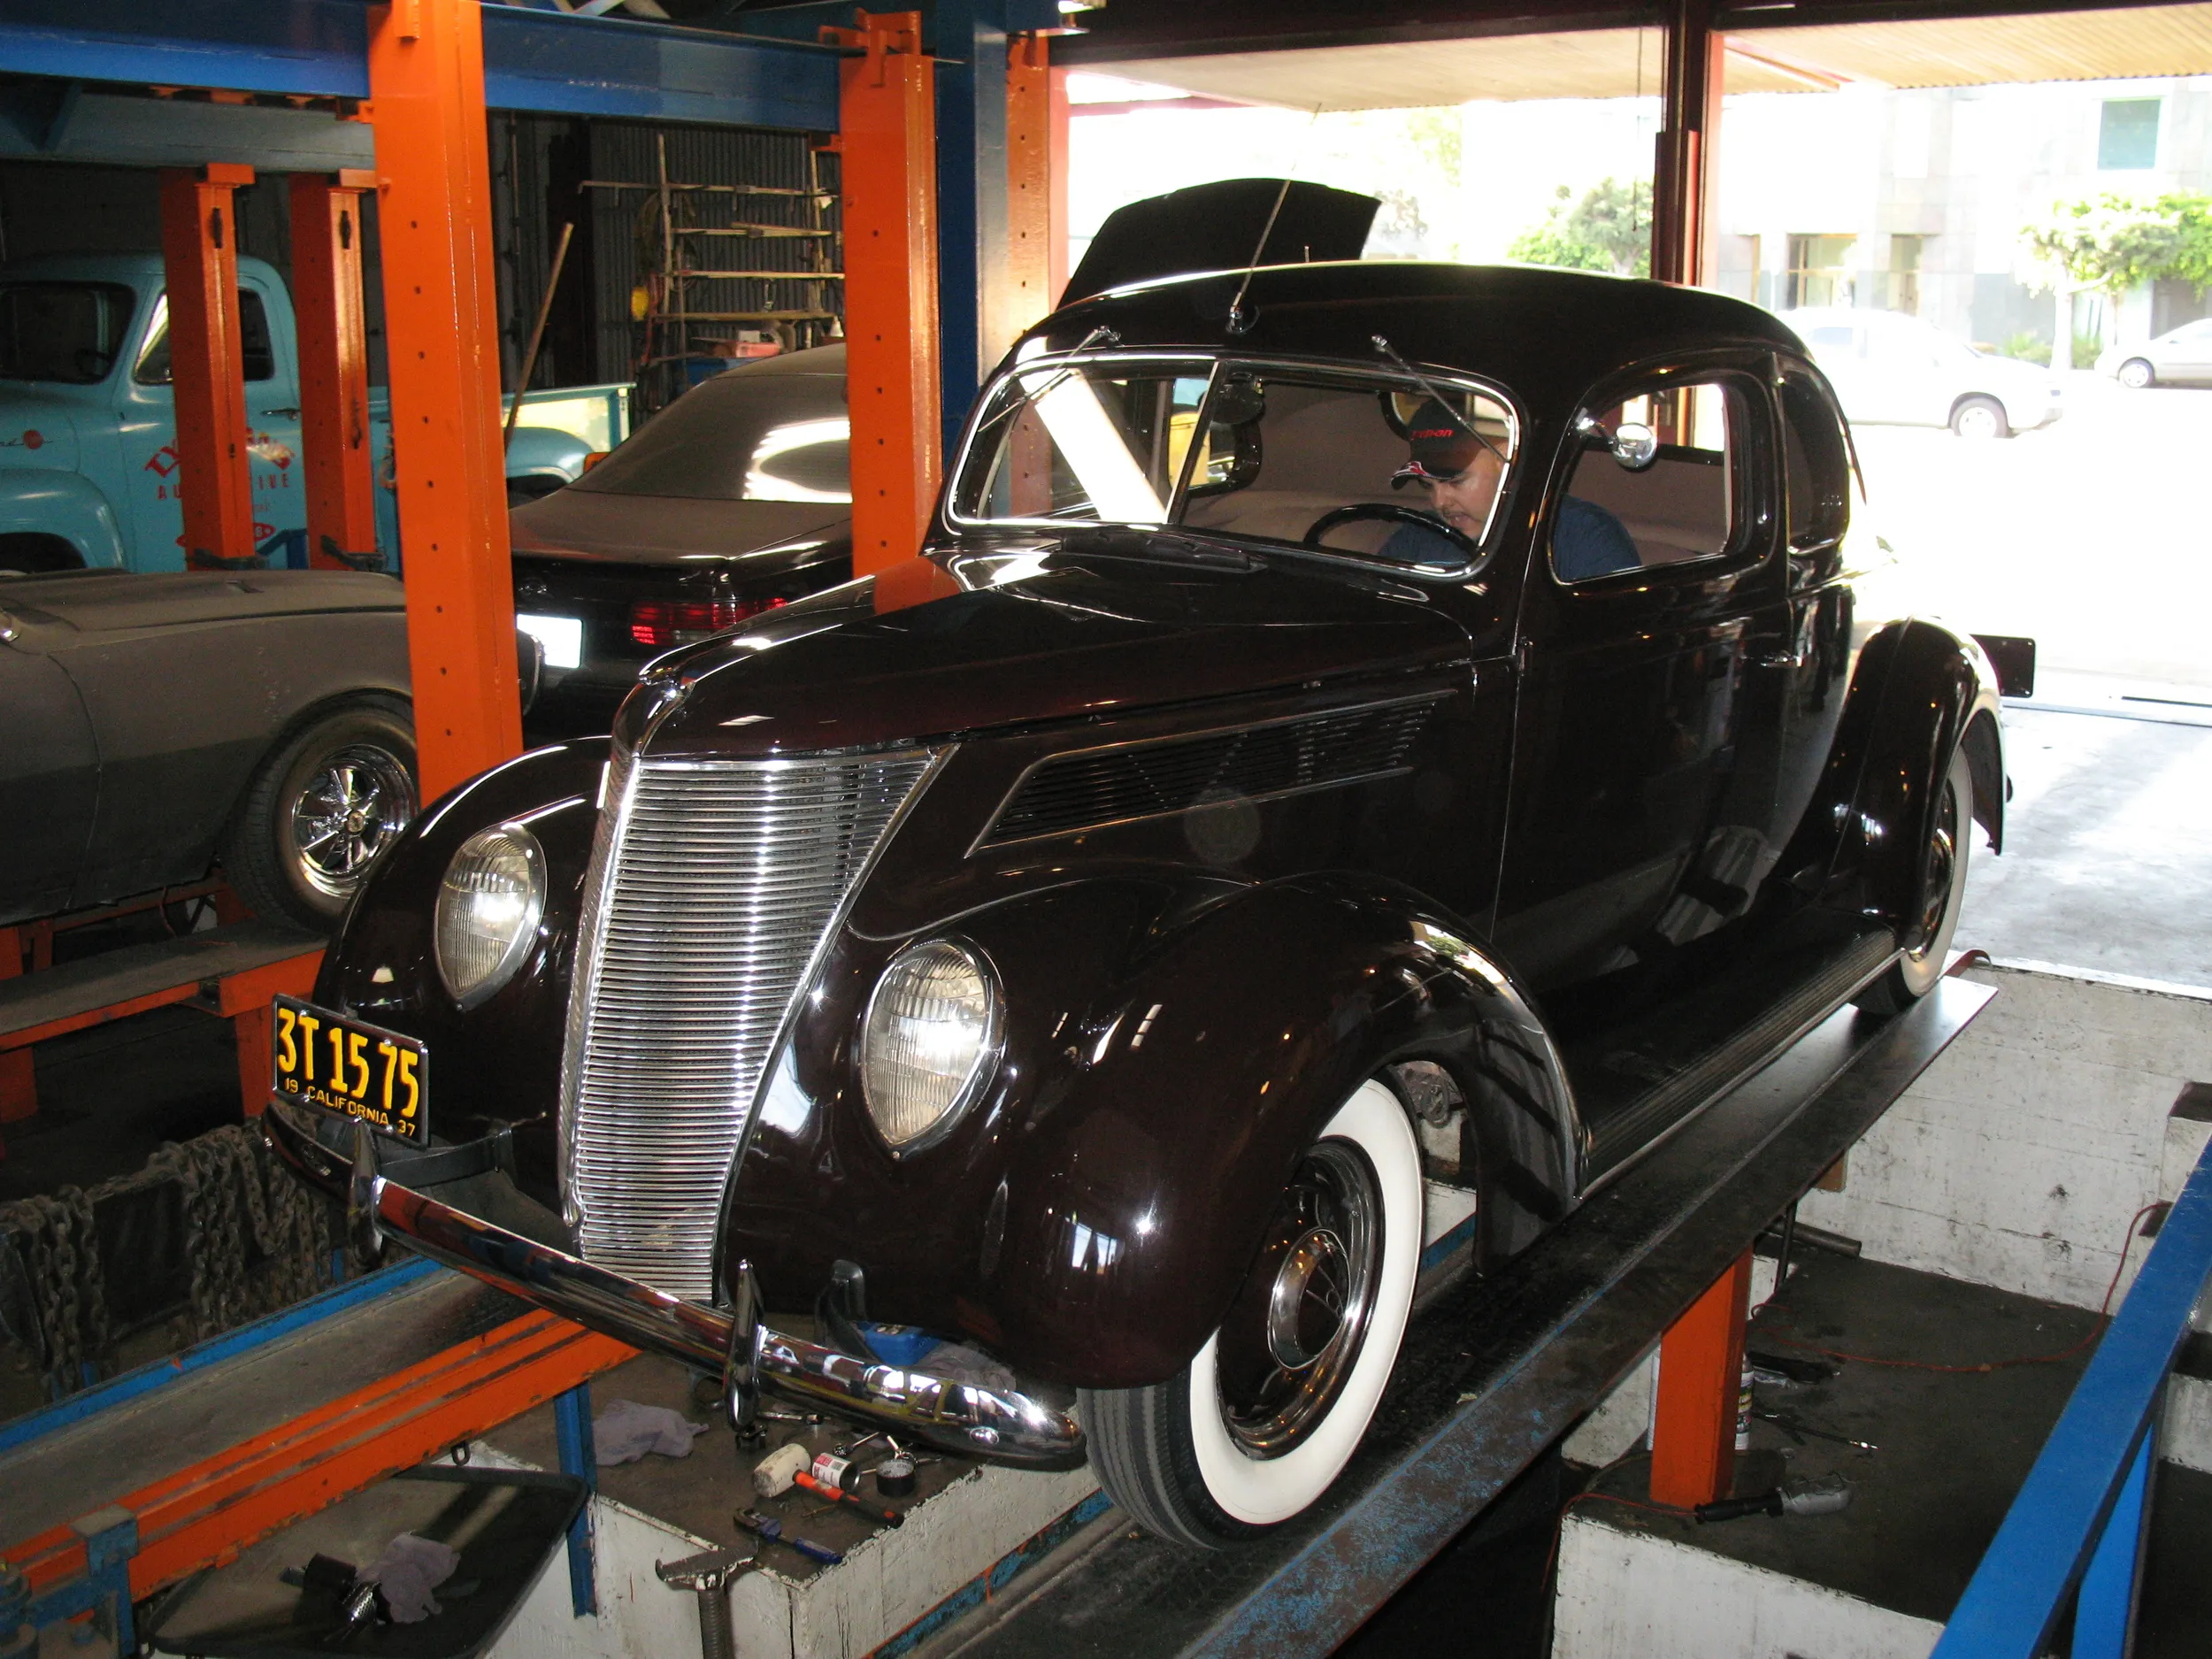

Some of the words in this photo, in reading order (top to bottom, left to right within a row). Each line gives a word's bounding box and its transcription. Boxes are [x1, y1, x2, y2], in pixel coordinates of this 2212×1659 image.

[277, 1008, 319, 1080] 3T
[328, 1027, 370, 1099] 15
[378, 1042, 419, 1118] 75
[284, 1077, 298, 1093] 19
[307, 1085, 389, 1125] CALIFORNIA
[397, 1119, 416, 1137] 37
